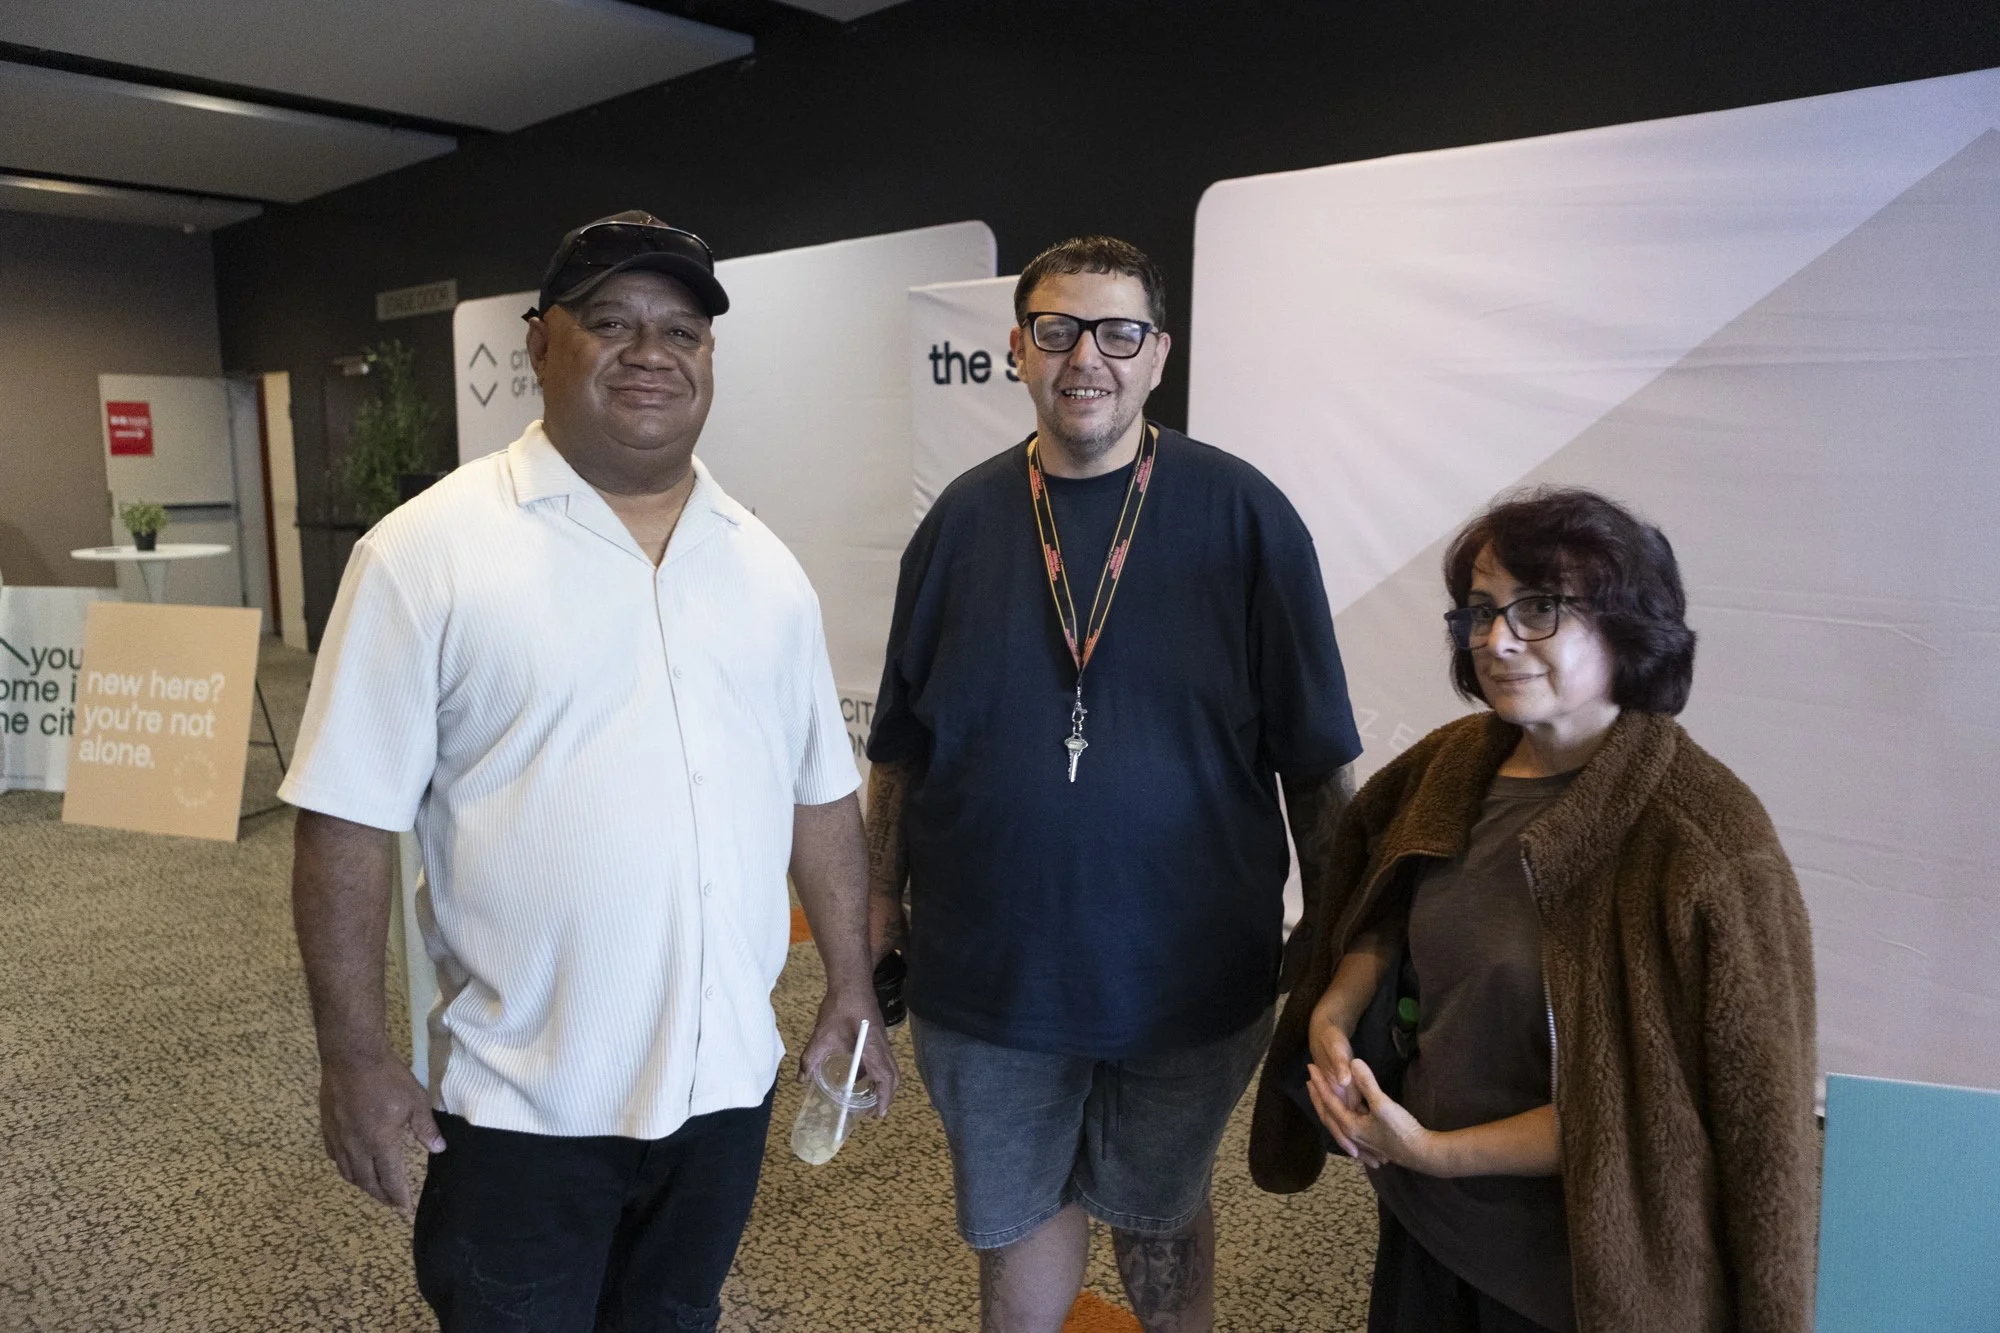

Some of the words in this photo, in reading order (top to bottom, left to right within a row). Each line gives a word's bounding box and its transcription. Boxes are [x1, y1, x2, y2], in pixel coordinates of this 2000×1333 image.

[928, 341, 992, 384] the
[87, 671, 143, 697] new
[149, 669, 226, 703] here?
[41, 707, 75, 736] cit
[83, 701, 163, 735] you're
[169, 709, 217, 739] not
[840, 697, 873, 726] CIT
[78, 732, 157, 769] alone.
